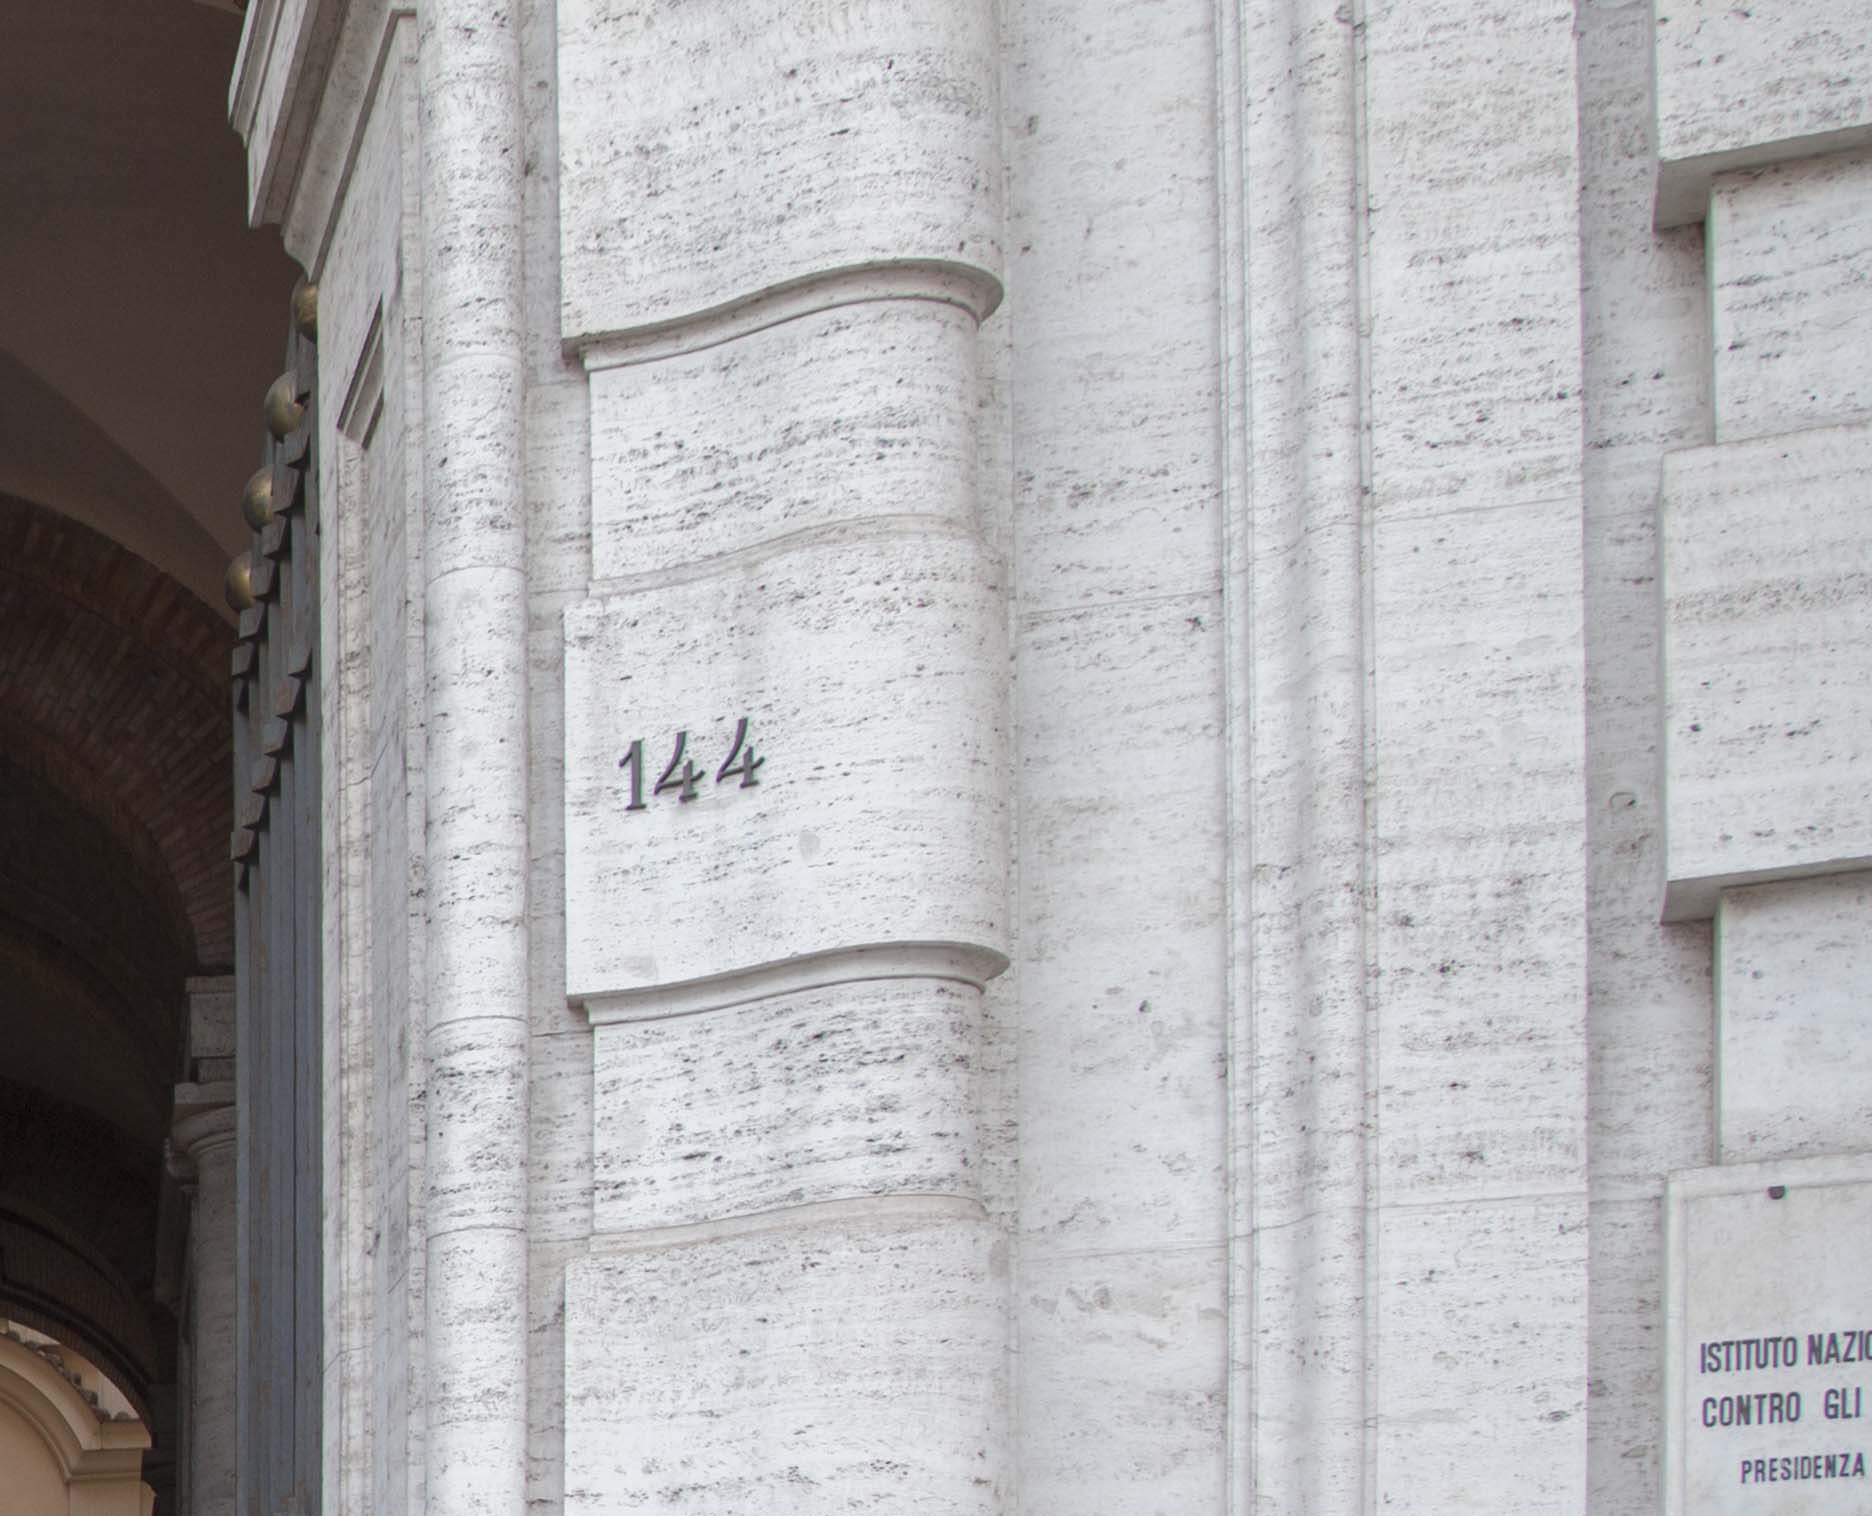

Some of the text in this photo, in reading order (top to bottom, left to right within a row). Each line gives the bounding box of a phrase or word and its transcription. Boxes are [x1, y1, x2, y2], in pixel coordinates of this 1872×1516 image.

[619, 717, 765, 810] 144
[1700, 1336, 1798, 1374] ISTITUTO
[1702, 1387, 1861, 1428] CONTRO GLI
[1741, 1452, 1865, 1484] PRESIDENZA
